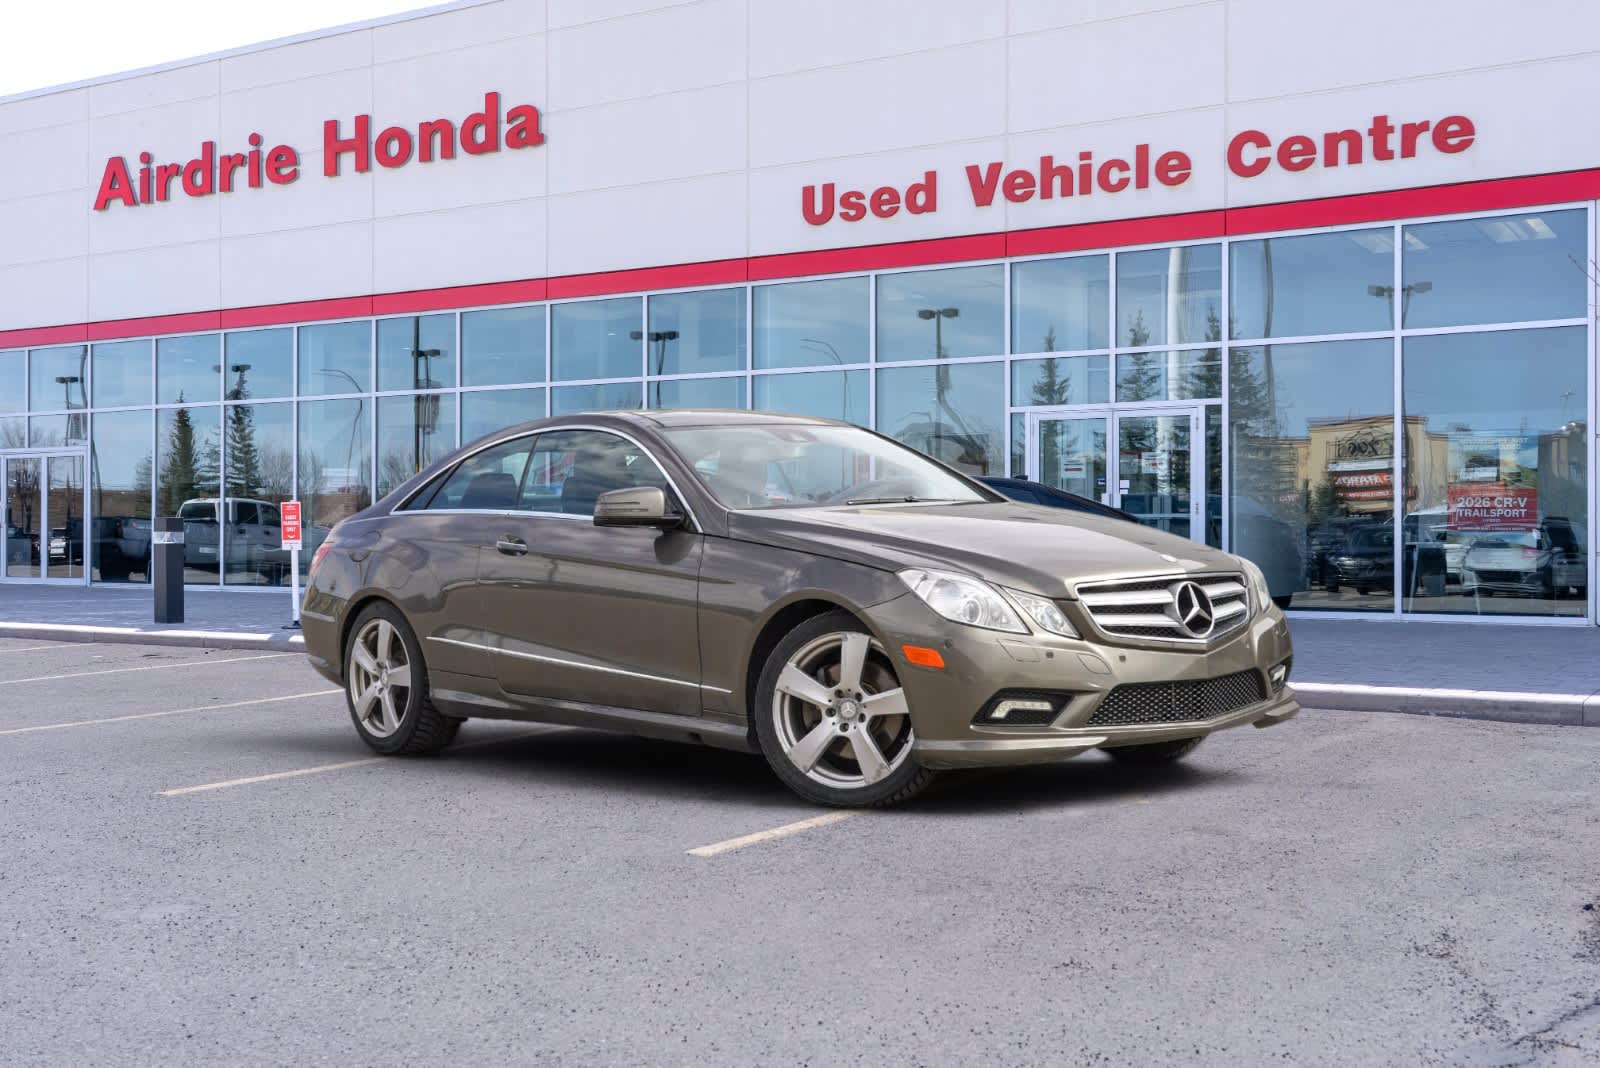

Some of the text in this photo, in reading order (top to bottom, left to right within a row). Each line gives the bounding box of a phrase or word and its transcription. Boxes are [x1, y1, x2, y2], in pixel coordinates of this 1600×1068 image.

[93, 91, 546, 210] Airdrie Honda
[801, 115, 1477, 226] Used Vehicle Centre
[1456, 497, 1528, 508] 2026 CR-V
[1457, 508, 1528, 518] TRAILSPORT
